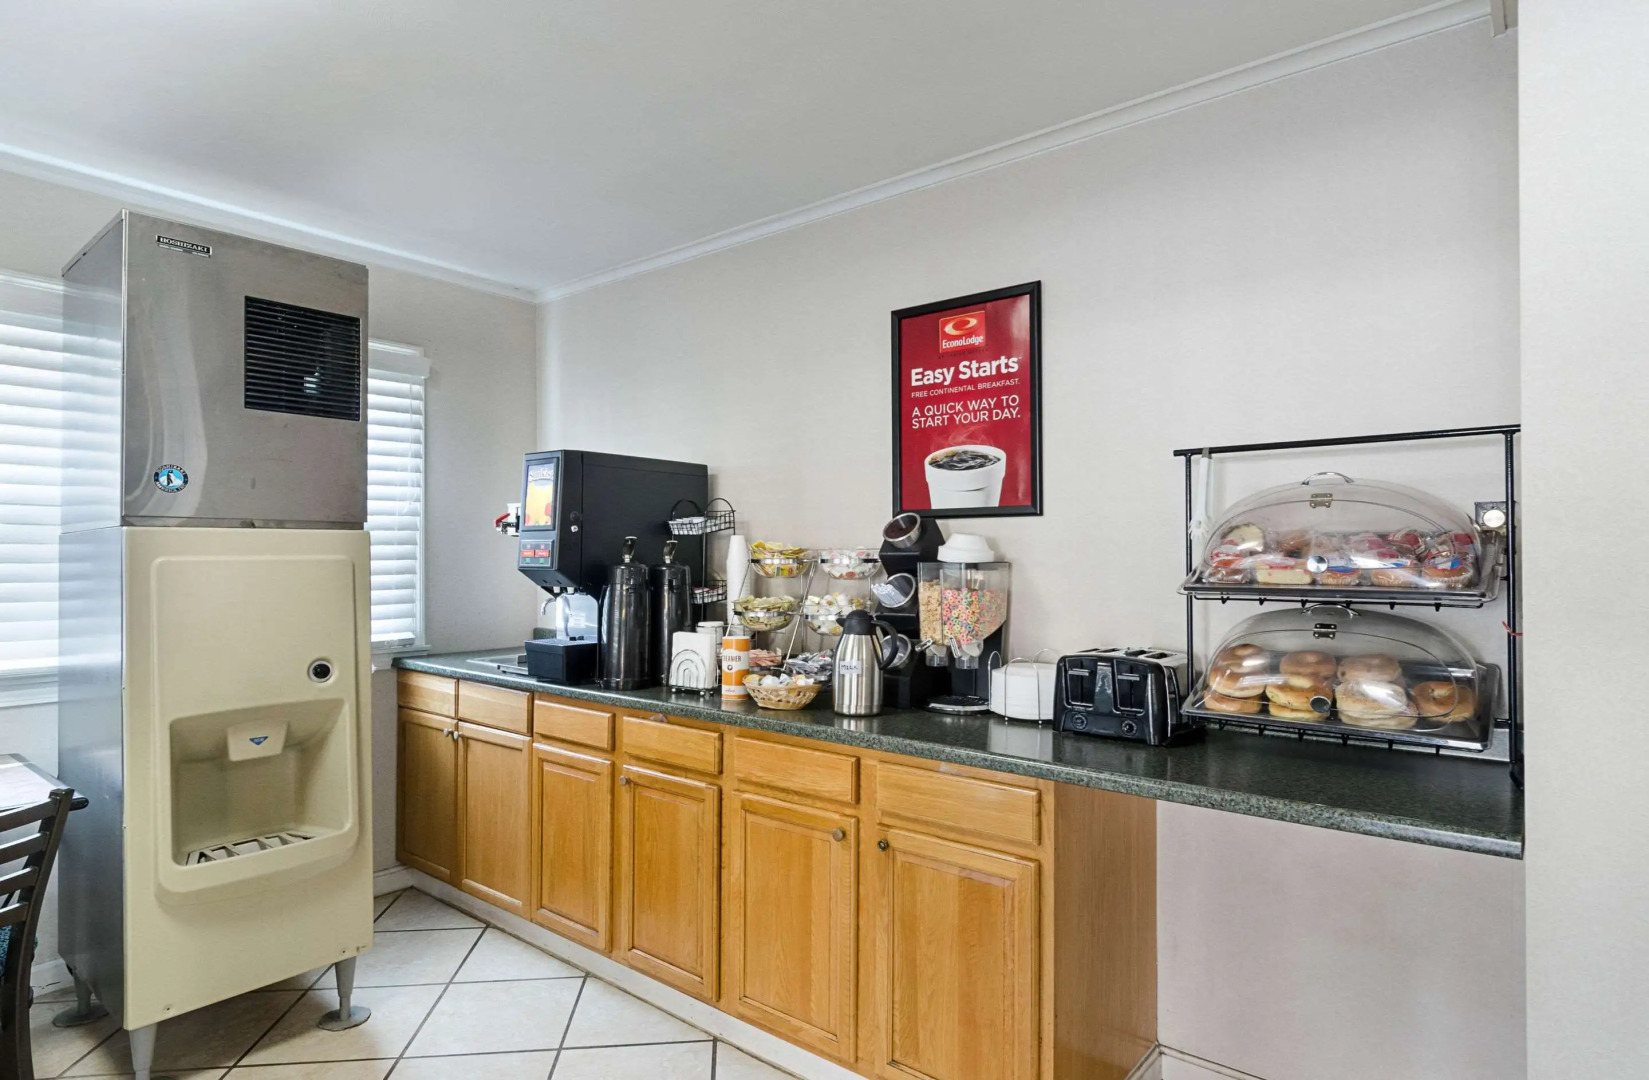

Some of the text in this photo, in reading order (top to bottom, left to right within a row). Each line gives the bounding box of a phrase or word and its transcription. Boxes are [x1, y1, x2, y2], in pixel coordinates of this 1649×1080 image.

[160, 237, 208, 252] HOSHIZAKI
[942, 335, 984, 348] EconoLodge
[911, 355, 1019, 387] Easy Starts
[930, 384, 975, 396] CONTINENTAL
[912, 395, 1019, 417] A QUICK WAY TO
[912, 407, 1021, 429] START YOUR DAY.
